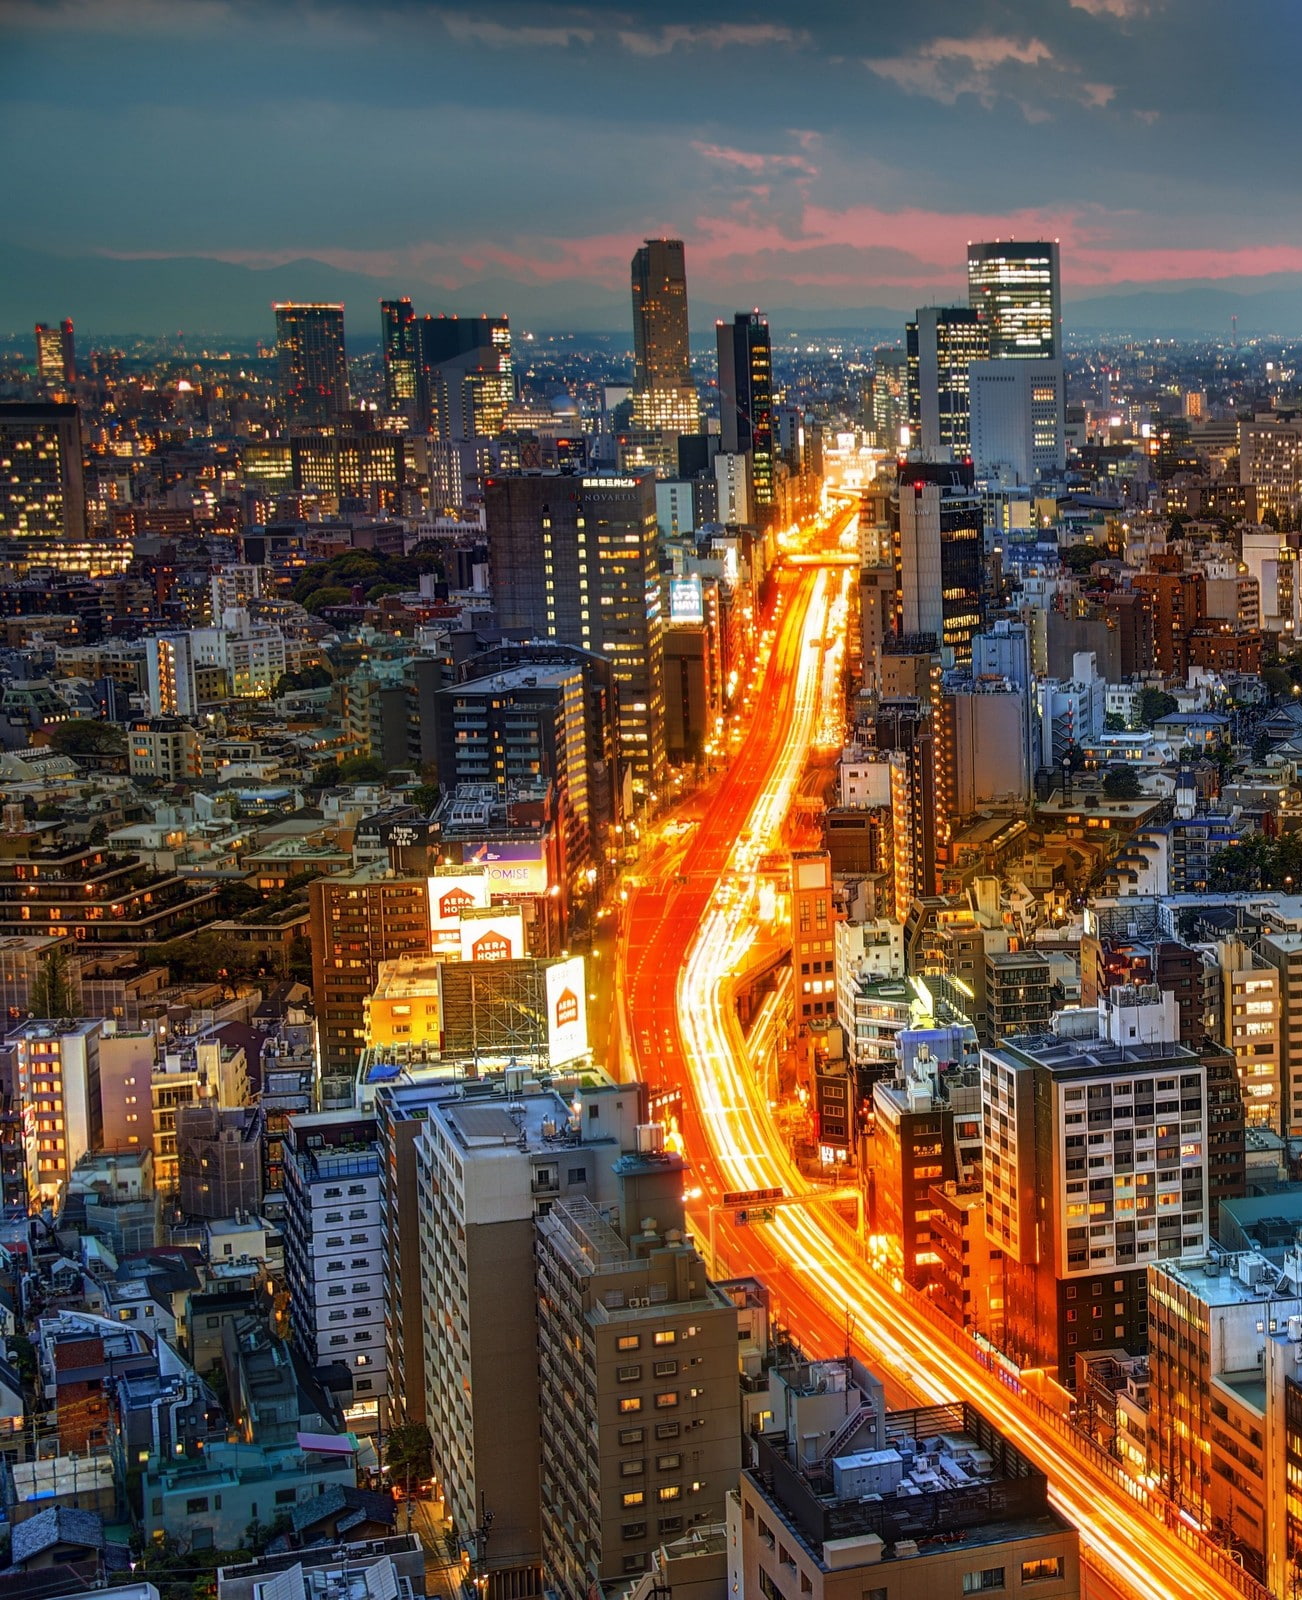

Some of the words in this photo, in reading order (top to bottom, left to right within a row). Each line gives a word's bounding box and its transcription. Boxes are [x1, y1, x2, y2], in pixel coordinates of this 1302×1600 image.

[584, 493, 640, 502] NOVARTIS
[673, 600, 700, 610] NAVI
[489, 868, 529, 880] OMISE
[443, 897, 472, 906] AERA
[477, 940, 507, 952] AERA
[477, 949, 508, 961] HOME
[558, 997, 577, 1013] AERA
[558, 1006, 578, 1021] HOME
